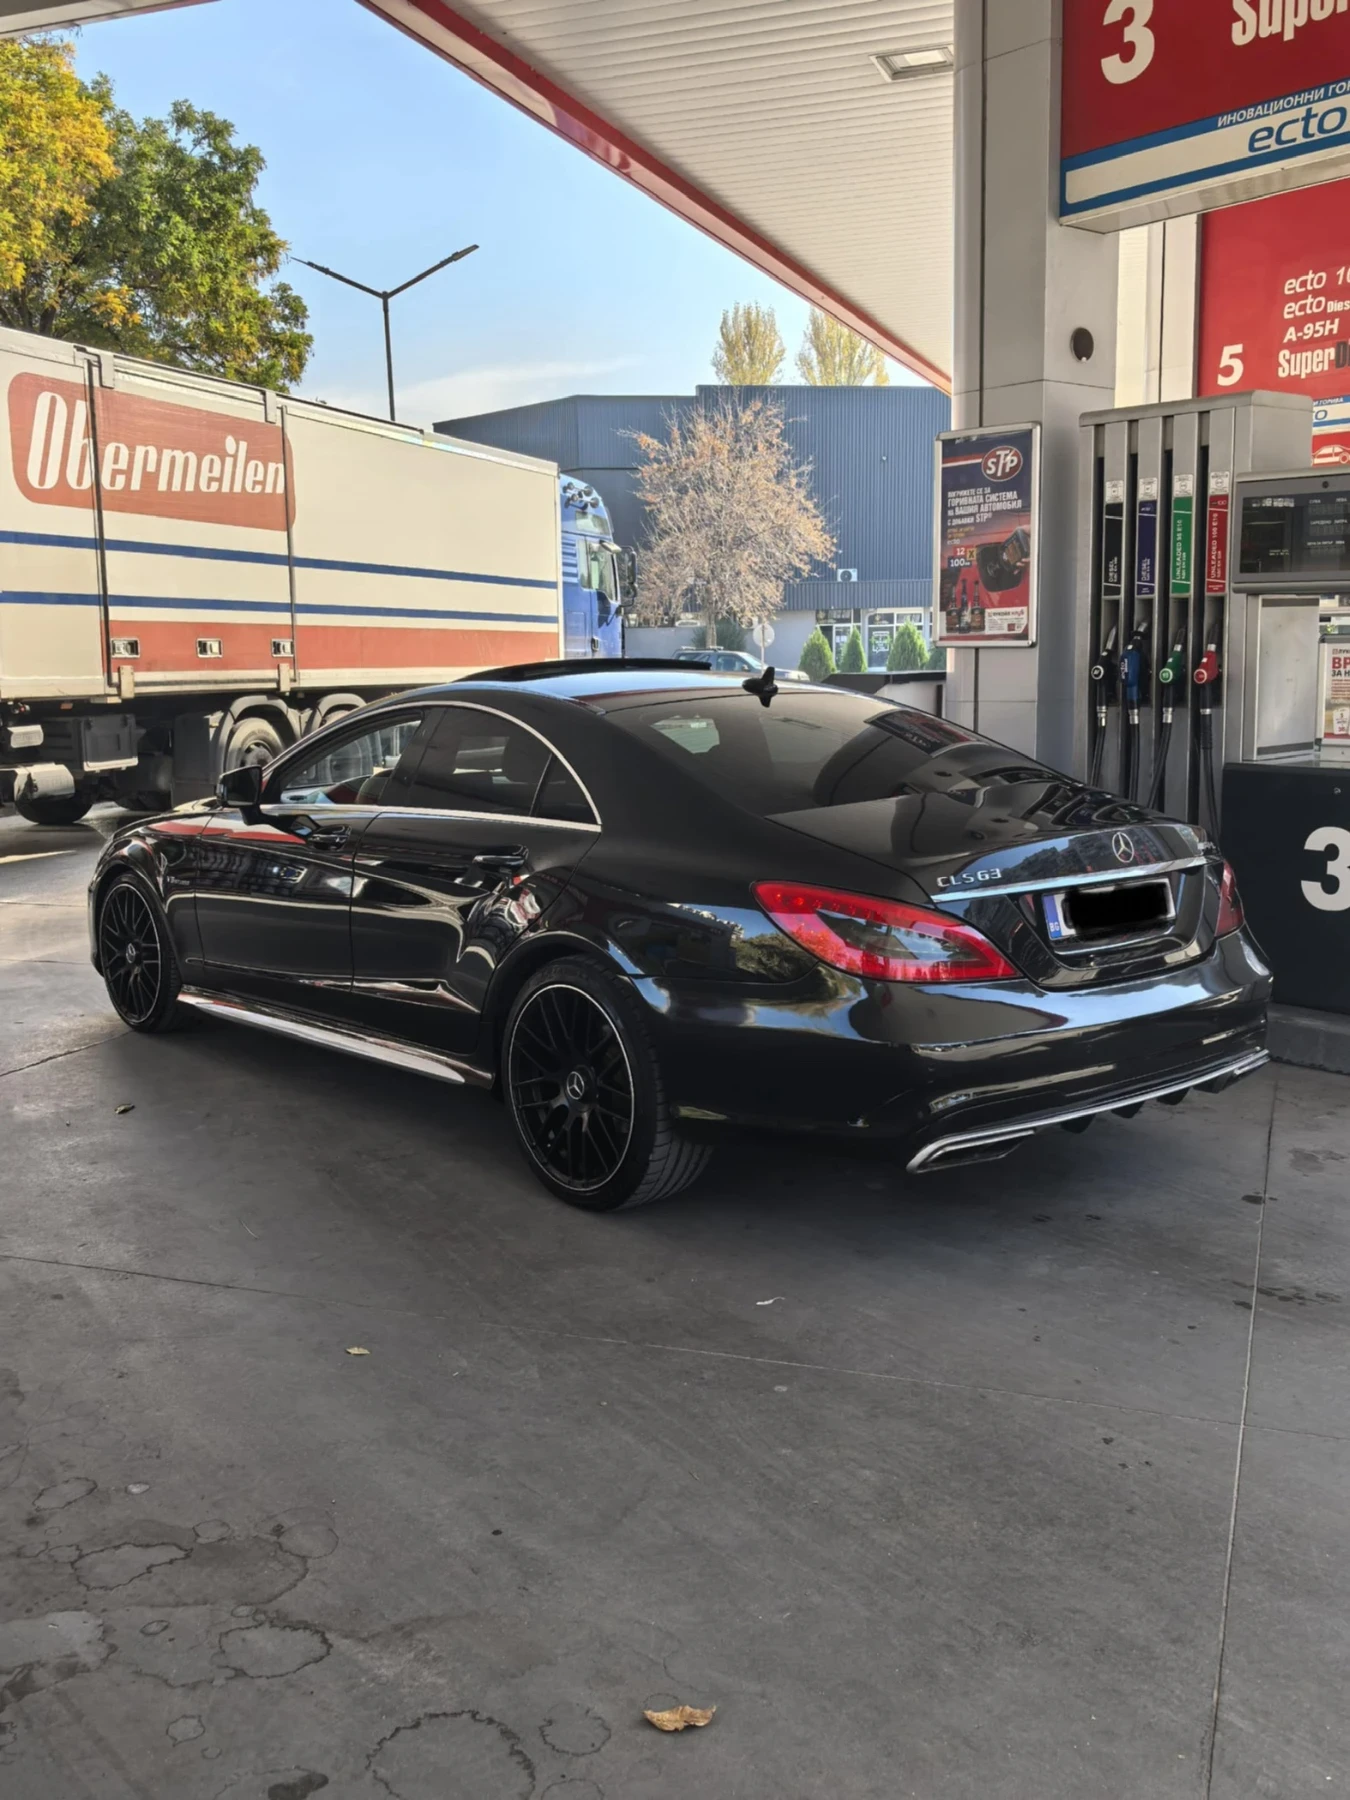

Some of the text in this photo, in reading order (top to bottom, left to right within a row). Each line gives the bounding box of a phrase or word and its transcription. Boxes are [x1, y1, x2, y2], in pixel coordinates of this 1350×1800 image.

[1101, 0, 1155, 84] 3
[1217, 87, 1325, 128] ИНОВАЦИОННИ
[1248, 106, 1348, 153] ecto
[1284, 269, 1327, 295] ecto
[1283, 294, 1326, 319] ecto
[1217, 343, 1244, 387] 5
[26, 390, 285, 494] Obermeilen
[986, 449, 1018, 477] STP
[947, 490, 1018, 508] ГОРИВНАТА СИСТЕМА
[980, 499, 1022, 513] АВТОМОБИЛ
[956, 547, 966, 556] 12
[1331, 669, 1342, 677] ЗА
[1301, 826, 1350, 911] 3
[1050, 921, 1060, 932] BG
